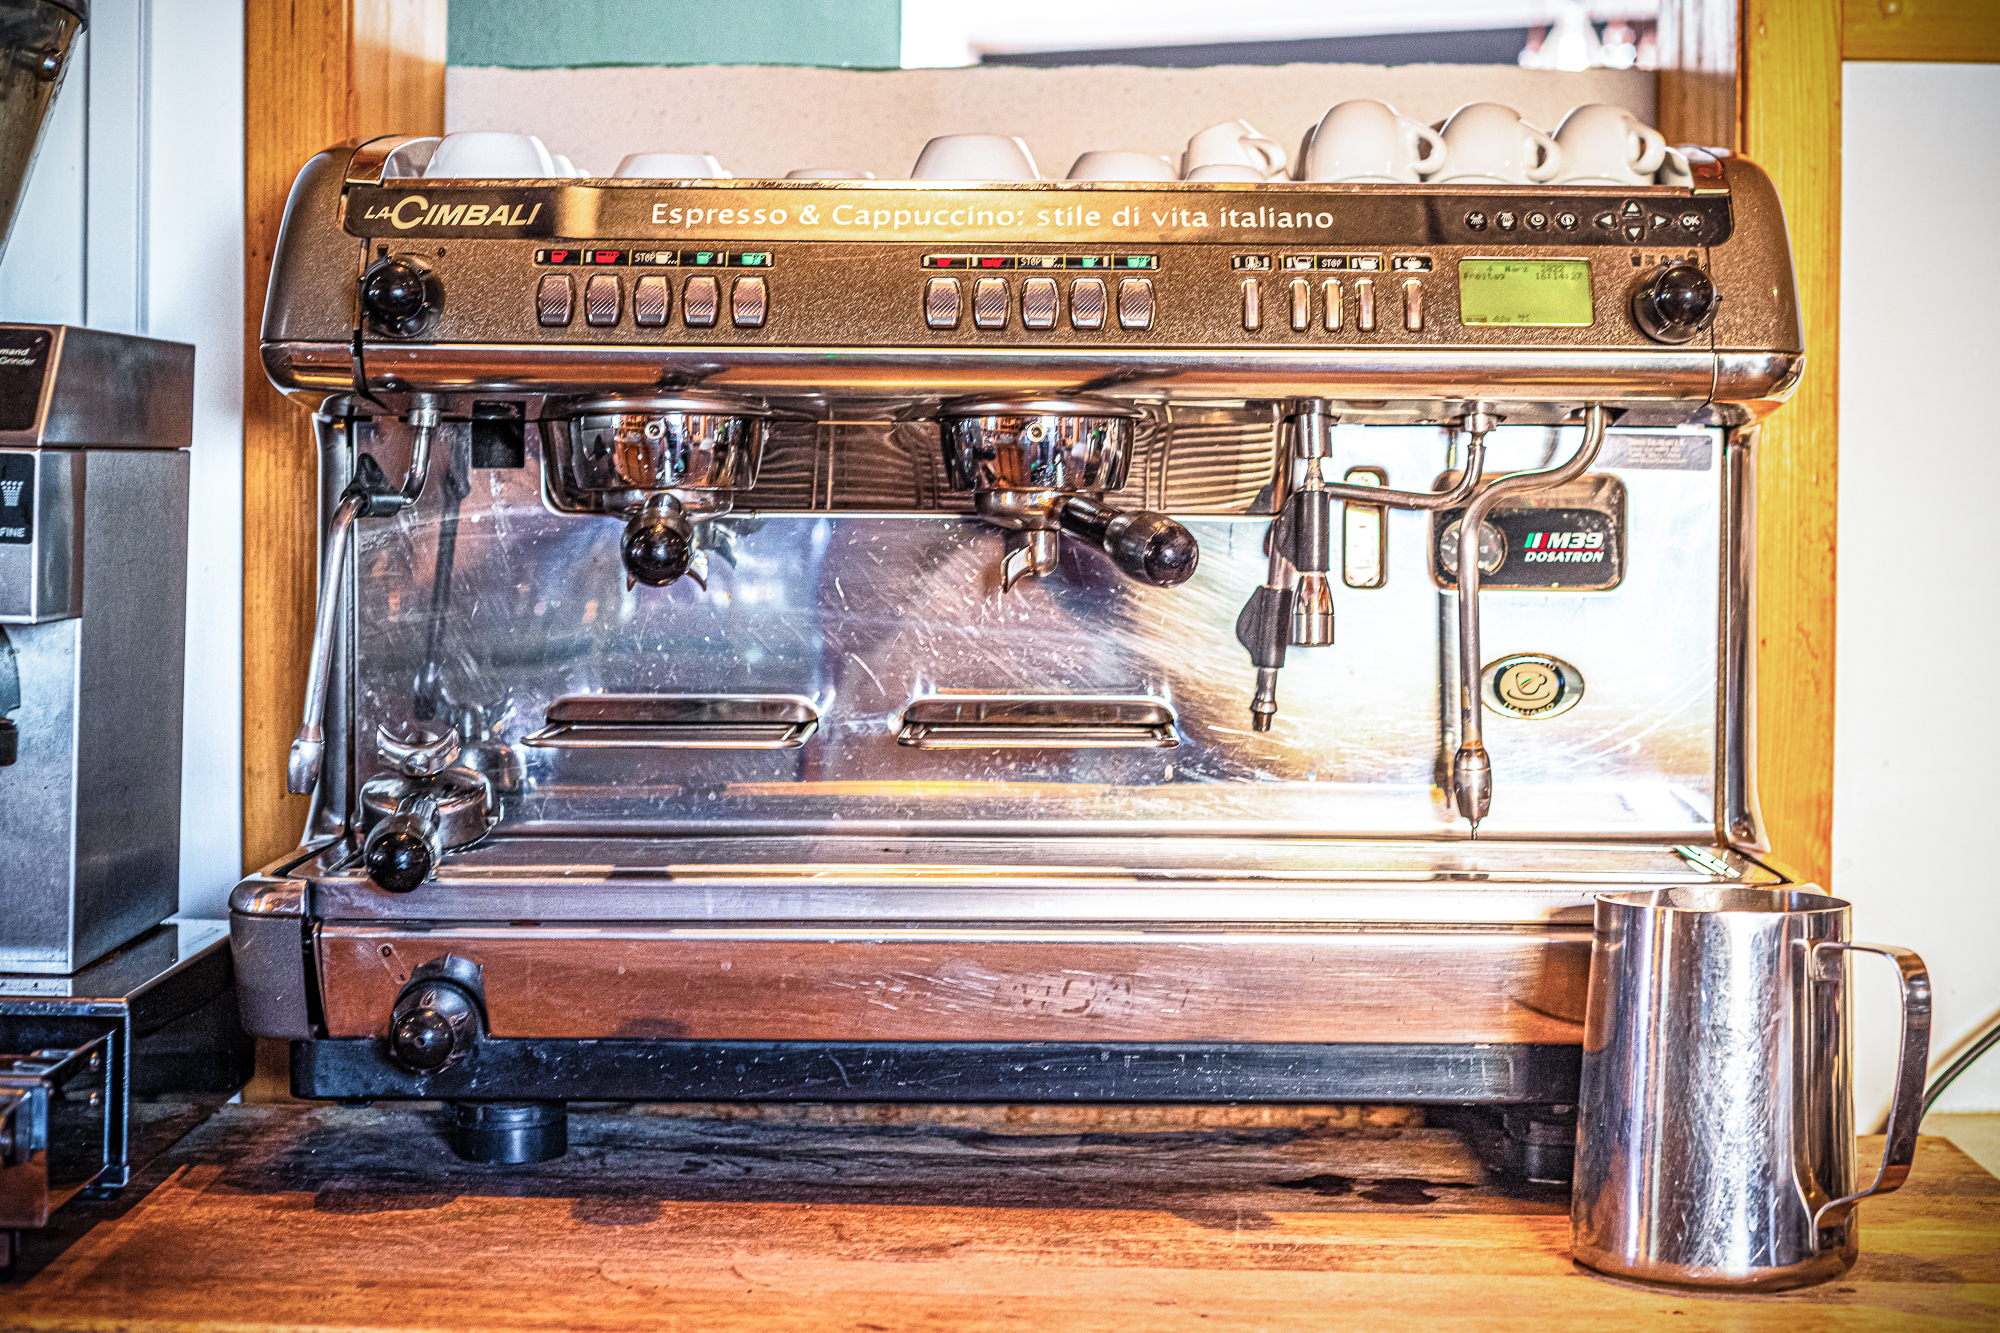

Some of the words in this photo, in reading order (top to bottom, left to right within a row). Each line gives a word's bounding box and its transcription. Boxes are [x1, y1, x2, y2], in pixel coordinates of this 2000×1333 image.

[363, 205, 391, 220] LA
[391, 195, 542, 230] CIMBALI
[651, 203, 788, 229] Espresso
[799, 204, 821, 225] &
[832, 204, 1024, 230] Cappuccino:
[1036, 205, 1101, 227] stile
[1111, 205, 1141, 227] di
[1150, 205, 1210, 228] vita
[1219, 206, 1335, 229] italiano
[1682, 215, 1700, 227] OK
[634, 252, 656, 263] STOP
[1020, 256, 1042, 266] STOP
[1321, 258, 1343, 268] STOP
[1547, 532, 1604, 549] M39
[1524, 551, 1605, 563] DOSATRON
